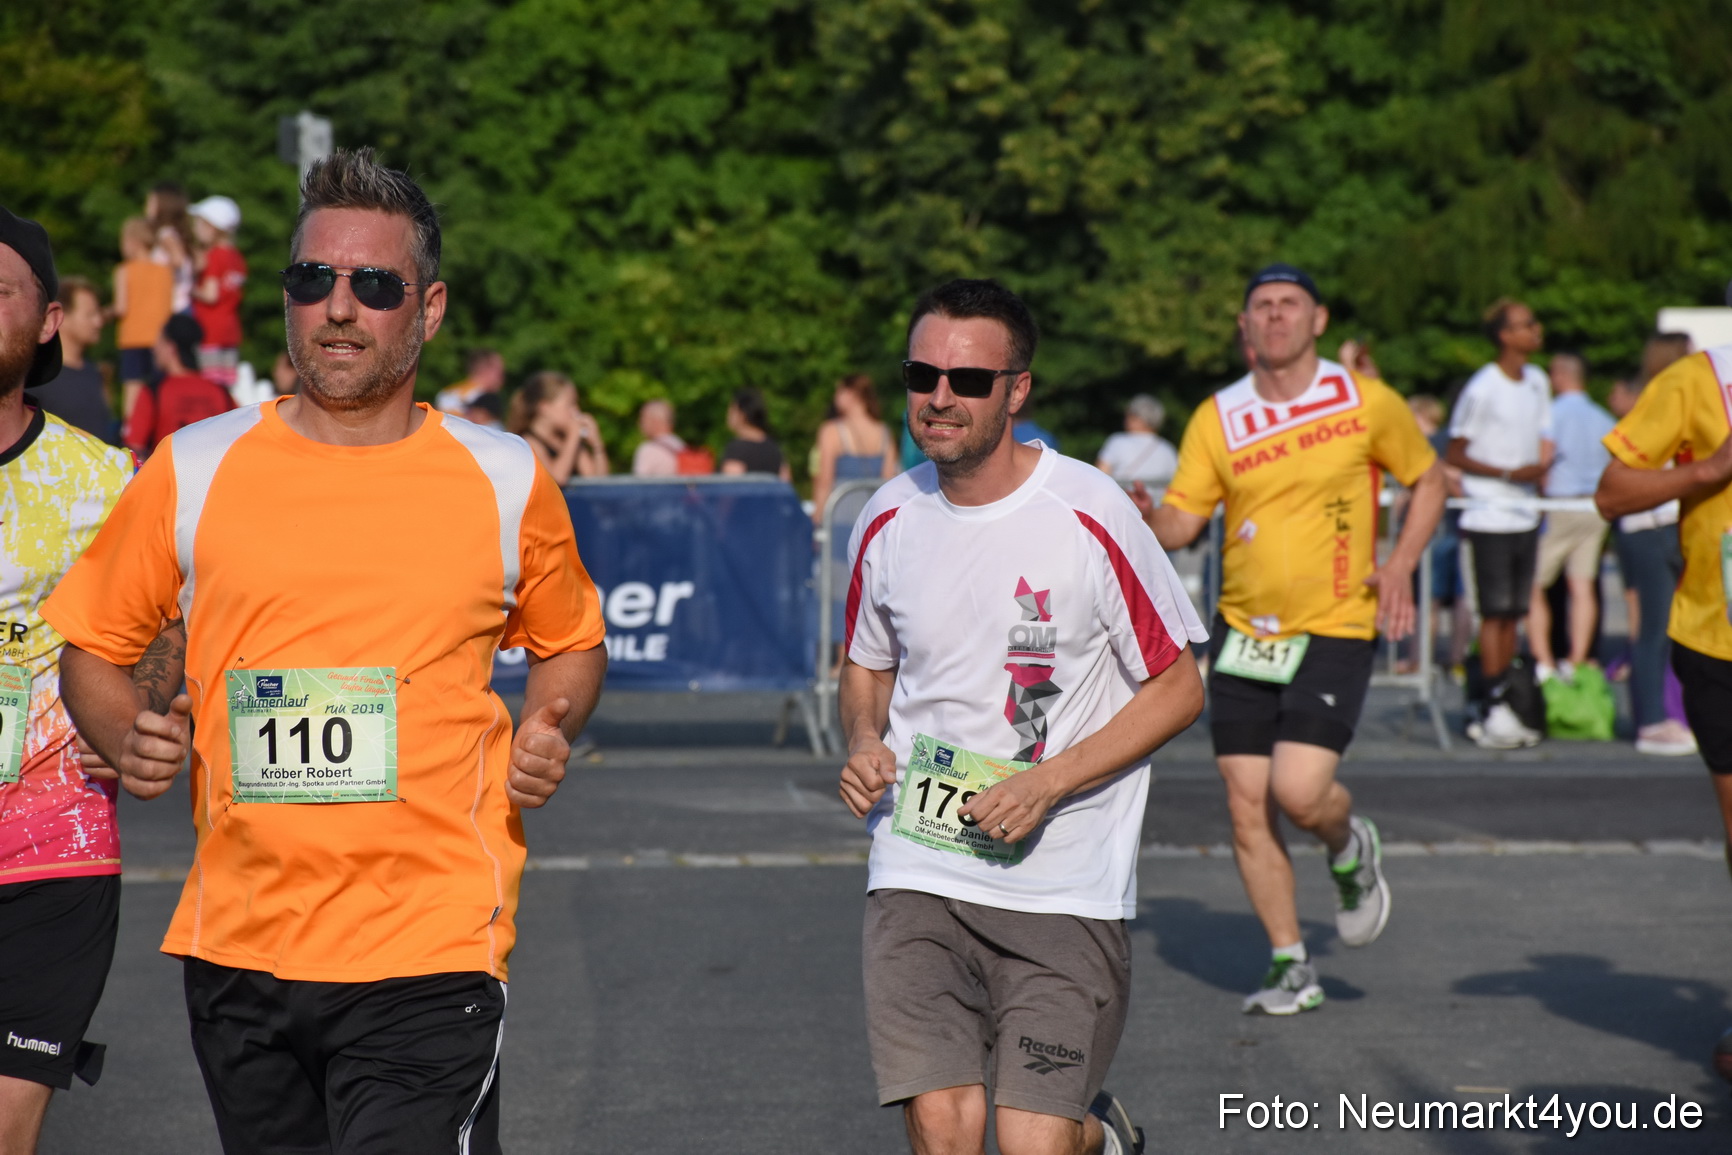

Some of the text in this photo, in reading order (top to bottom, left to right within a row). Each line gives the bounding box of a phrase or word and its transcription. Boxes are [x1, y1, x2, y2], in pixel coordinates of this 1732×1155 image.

[1232, 418, 1367, 476] MAX BÖGL
[1008, 624, 1057, 647] OM
[1239, 635, 1291, 666] 1541
[247, 694, 309, 708] firmenlauf
[352, 703, 384, 714] 2019
[259, 716, 353, 764] 110
[261, 766, 352, 779] Kröber Robert
[925, 758, 969, 780] firmenlauf
[302, 780, 324, 788] Spotka
[918, 816, 958, 834] Schaffer
[971, 841, 994, 851] GmbH
[7, 1031, 61, 1056] hummel
[1019, 1036, 1085, 1063] Reebok
